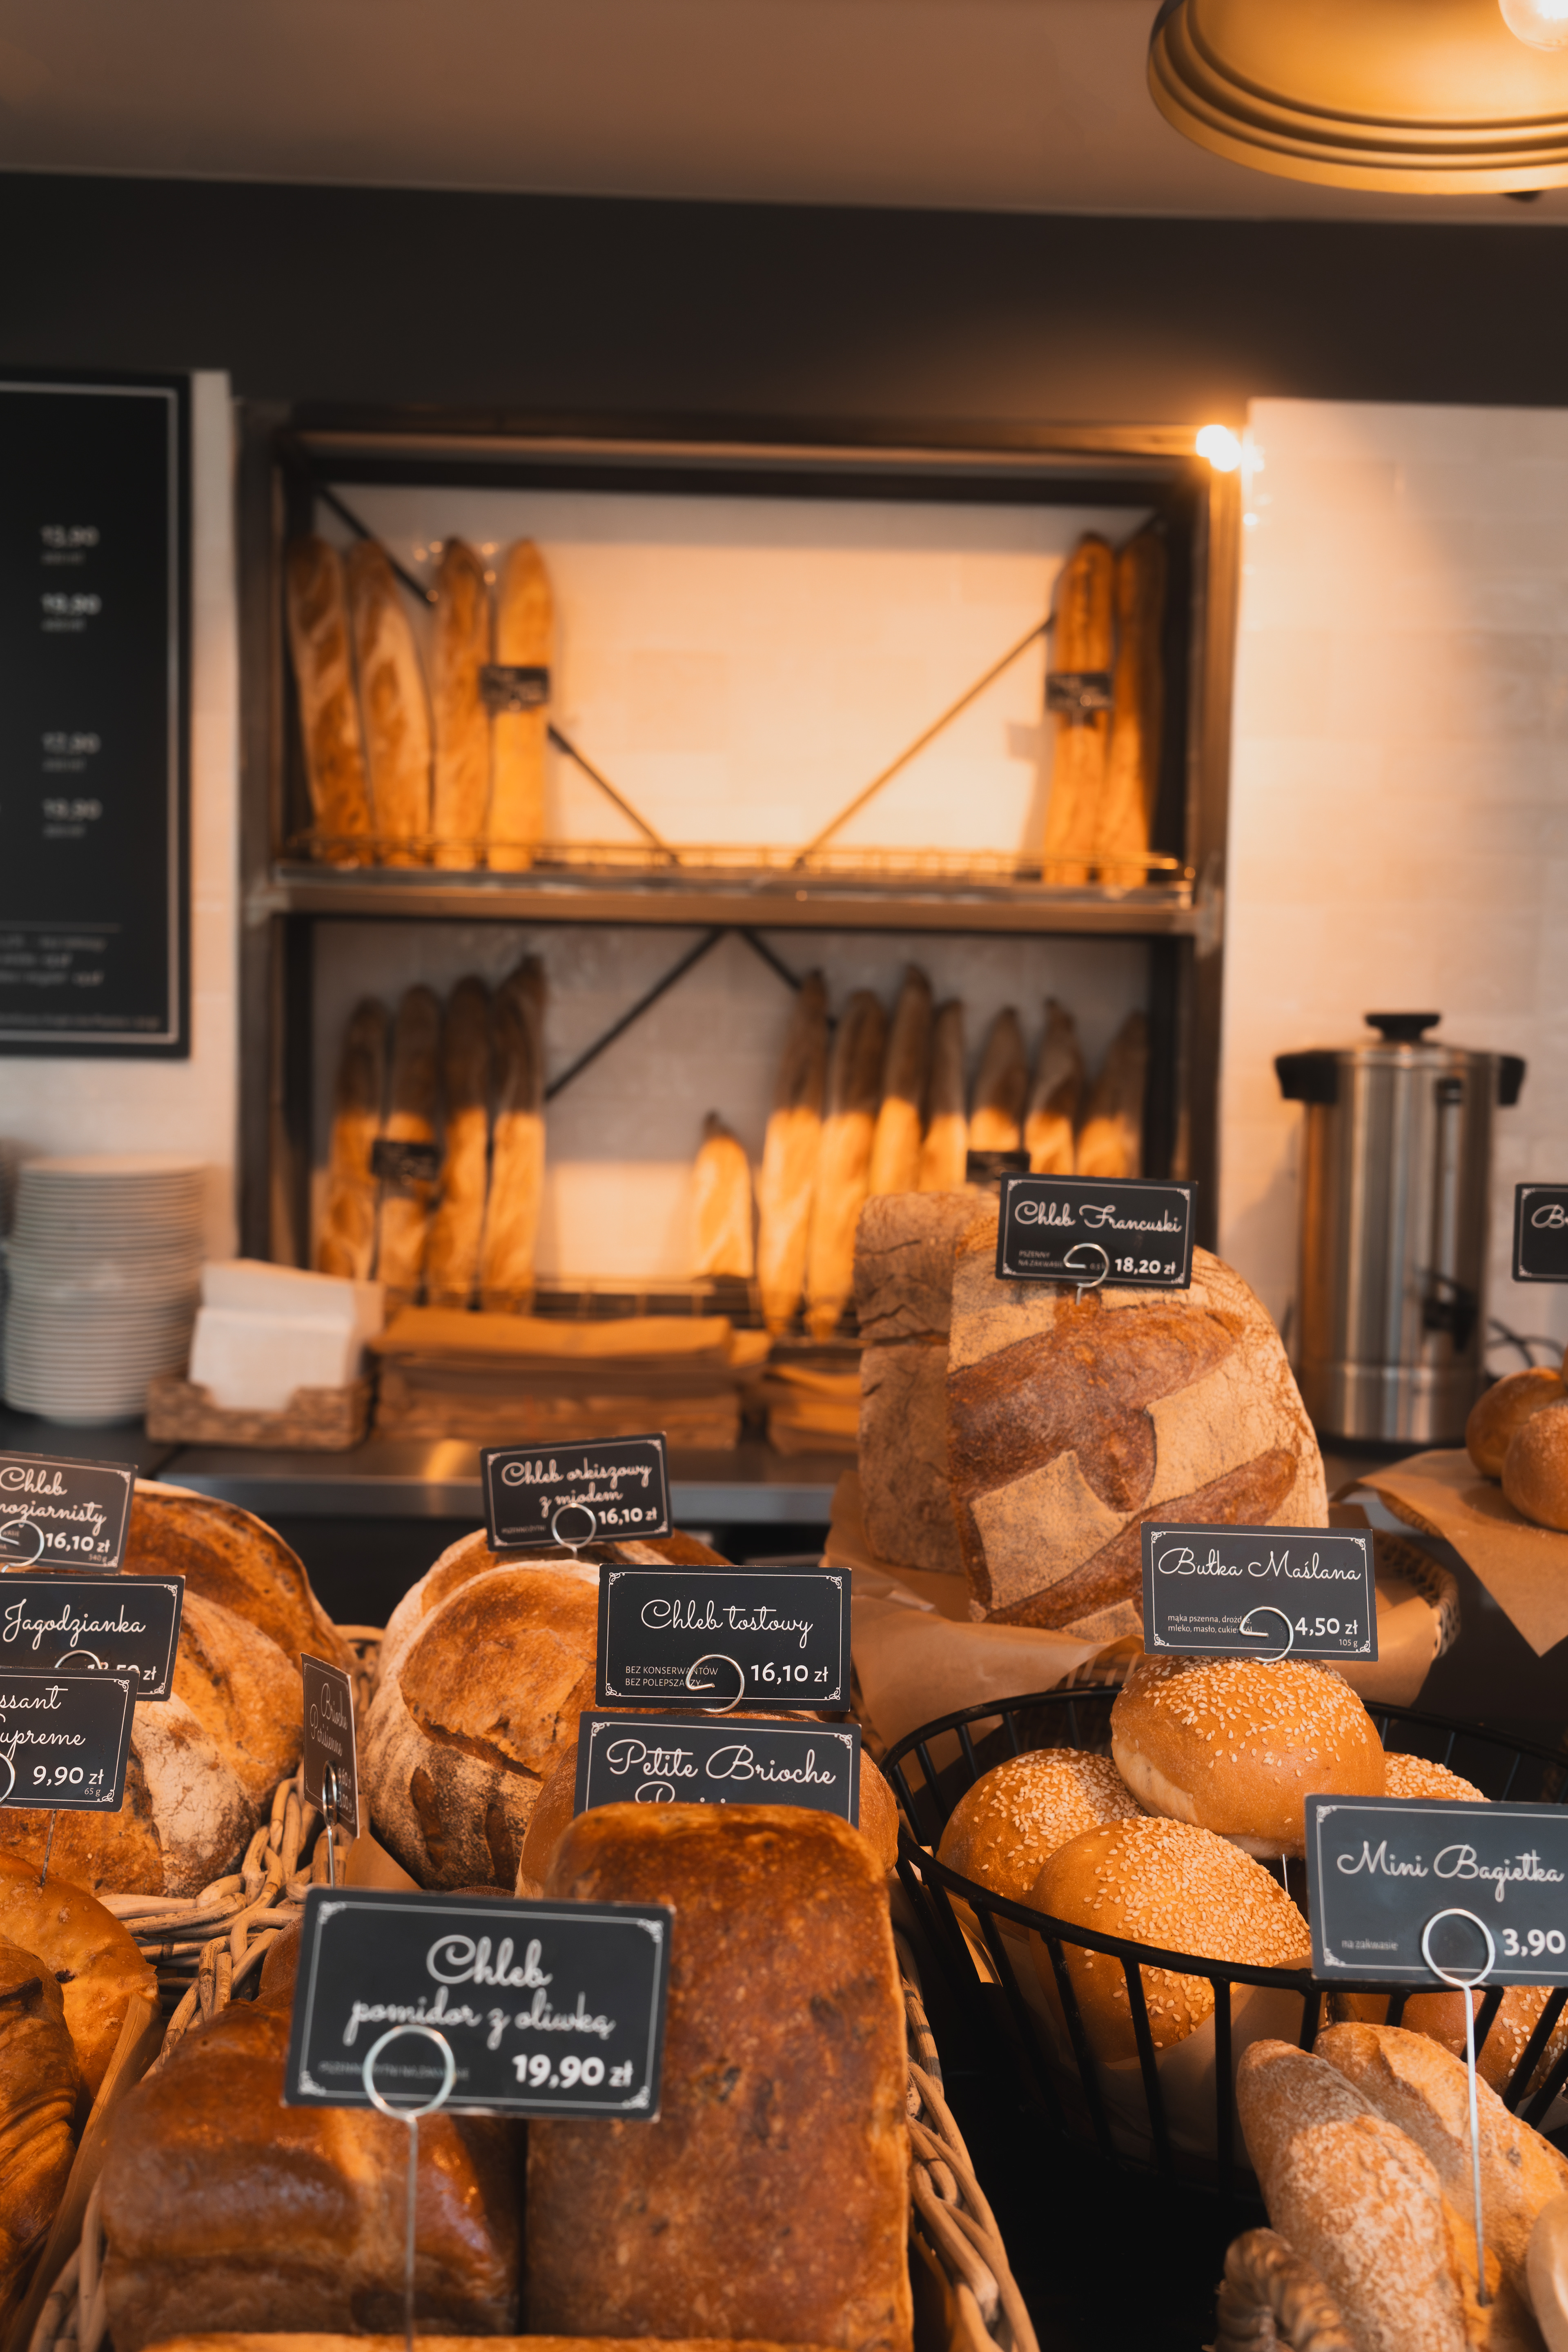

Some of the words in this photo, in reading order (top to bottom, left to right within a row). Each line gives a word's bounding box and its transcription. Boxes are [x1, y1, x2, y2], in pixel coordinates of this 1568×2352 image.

[1015, 1200, 1076, 1226] Chleb
[1079, 1205, 1182, 1232] Francuski
[1115, 1257, 1161, 1275] 18,20
[1163, 1261, 1176, 1275] zł
[0, 1466, 67, 1496] Chleb
[501, 1459, 564, 1487] Chleb
[567, 1457, 653, 1490] orkiszowy
[539, 1496, 552, 1518] z
[555, 1481, 624, 1506] miodem
[598, 1507, 643, 1526] 16,10
[645, 1506, 657, 1522] zł
[45, 1532, 94, 1552] 16,10
[96, 1539, 111, 1553] zł
[1158, 1547, 1243, 1577] Bułka
[1247, 1550, 1361, 1581] Maślana
[2, 1598, 146, 1650] Jagodzianka
[641, 1599, 724, 1630] Chleb
[722, 1605, 813, 1649] tostowy
[1168, 1613, 1188, 1623] mąka
[1189, 1615, 1221, 1624] pszenna,
[1221, 1615, 1252, 1624] drożde,
[1168, 1624, 1192, 1633] mleko,
[1193, 1625, 1217, 1633] masło,
[1294, 1617, 1340, 1637] 4,50
[1345, 1619, 1359, 1635] zł
[1353, 1640, 1358, 1648] g
[143, 1666, 157, 1681] zł
[625, 1678, 641, 1686] BEZ
[643, 1678, 701, 1687] POLEPSZAZY
[626, 1666, 641, 1674] BEZ
[751, 1662, 809, 1685] 16,10
[814, 1666, 829, 1682] zł
[321, 1682, 347, 1730] Brioche
[310, 1703, 343, 1757] Parisienne
[32, 1765, 84, 1786] 9,90
[88, 1768, 104, 1785] zł
[606, 1738, 699, 1777] Petite
[706, 1744, 836, 1785] Brioche
[1336, 1840, 1428, 1877] Mini
[1433, 1844, 1565, 1902] Bagietka
[1502, 1928, 1566, 1957] 3,90
[426, 1934, 553, 1988] Chleb
[343, 1985, 482, 2046] pomidor
[487, 2007, 511, 2050] z
[514, 1987, 616, 2040] oliwką
[512, 2054, 606, 2089] 19,90
[608, 2059, 633, 2088] zł
